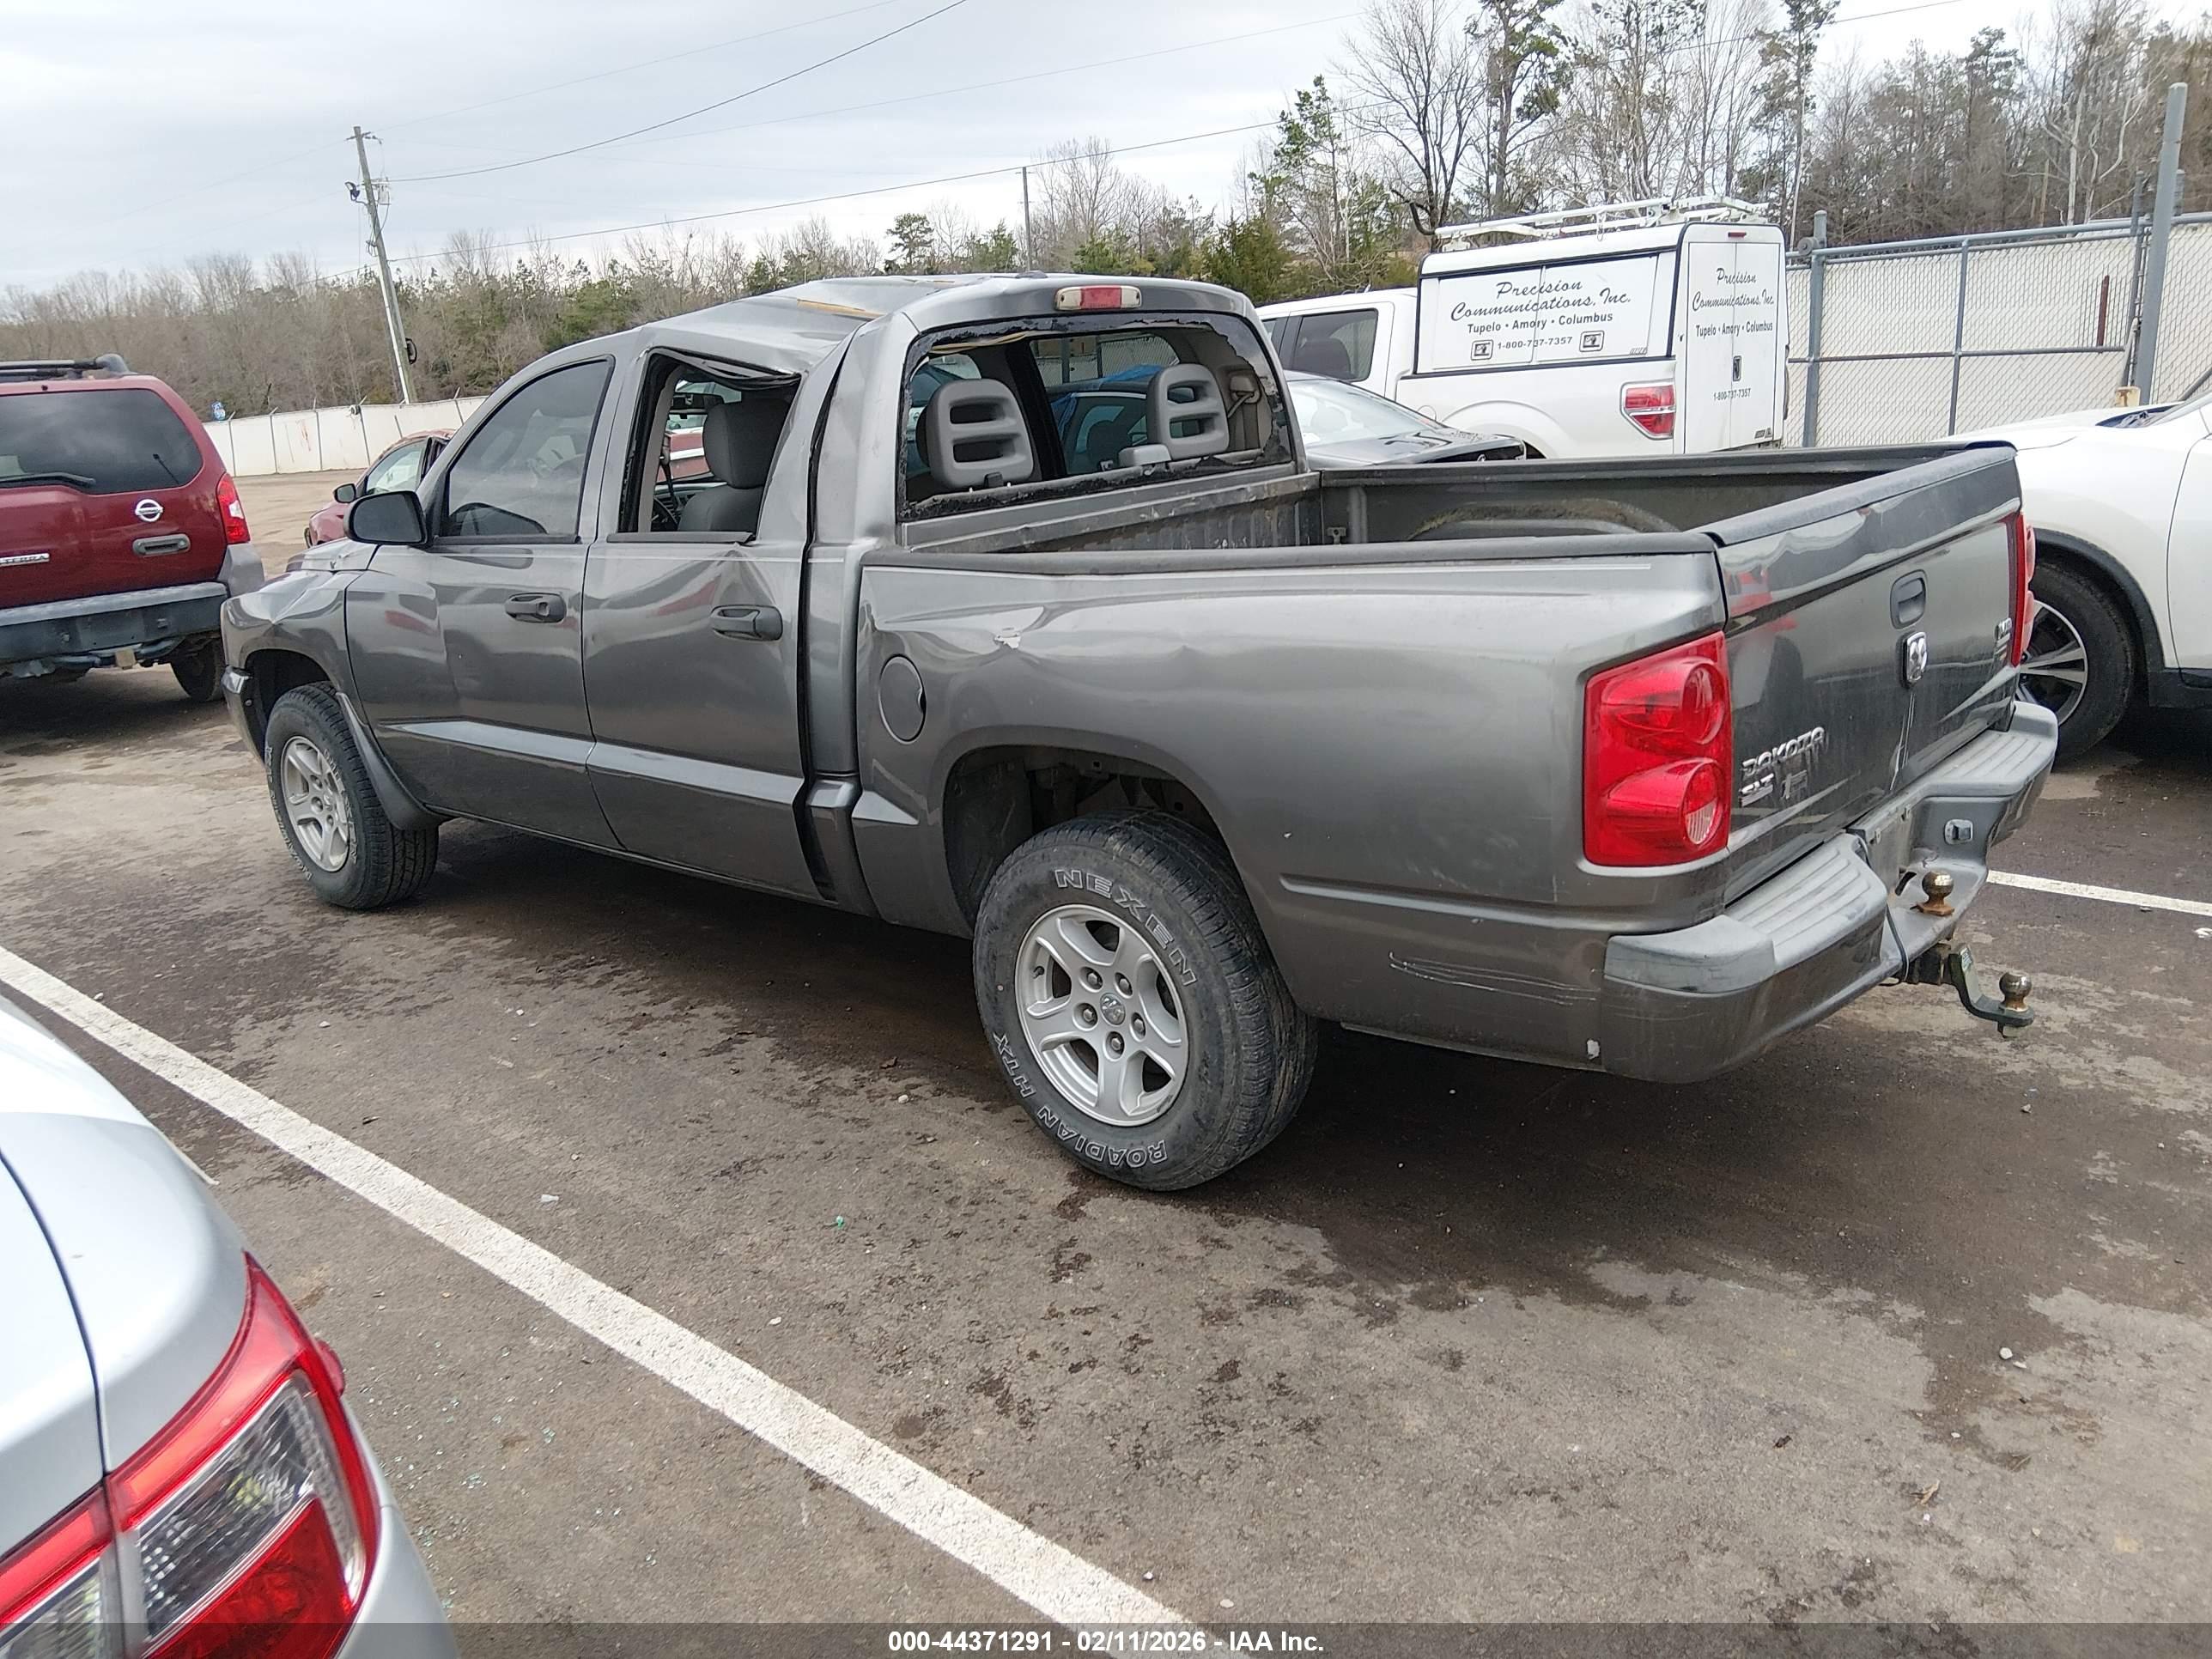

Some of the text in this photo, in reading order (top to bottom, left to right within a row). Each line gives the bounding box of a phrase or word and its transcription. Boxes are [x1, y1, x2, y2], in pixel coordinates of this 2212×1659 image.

[1717, 267, 1758, 285] Precision
[1496, 280, 1583, 299] Precision
[1450, 287, 1632, 321] Communications, Inc.
[1468, 312, 1613, 335] Tupelo Amory Columbus
[1696, 320, 1773, 339] Tupelo Amory Columbus
[1497, 336, 1573, 349] 1-800-737-7357
[1741, 726, 1826, 777] DAKOTA
[1054, 868, 1198, 987] NEXEN
[993, 1031, 1169, 1169] ROADIAN HTX
